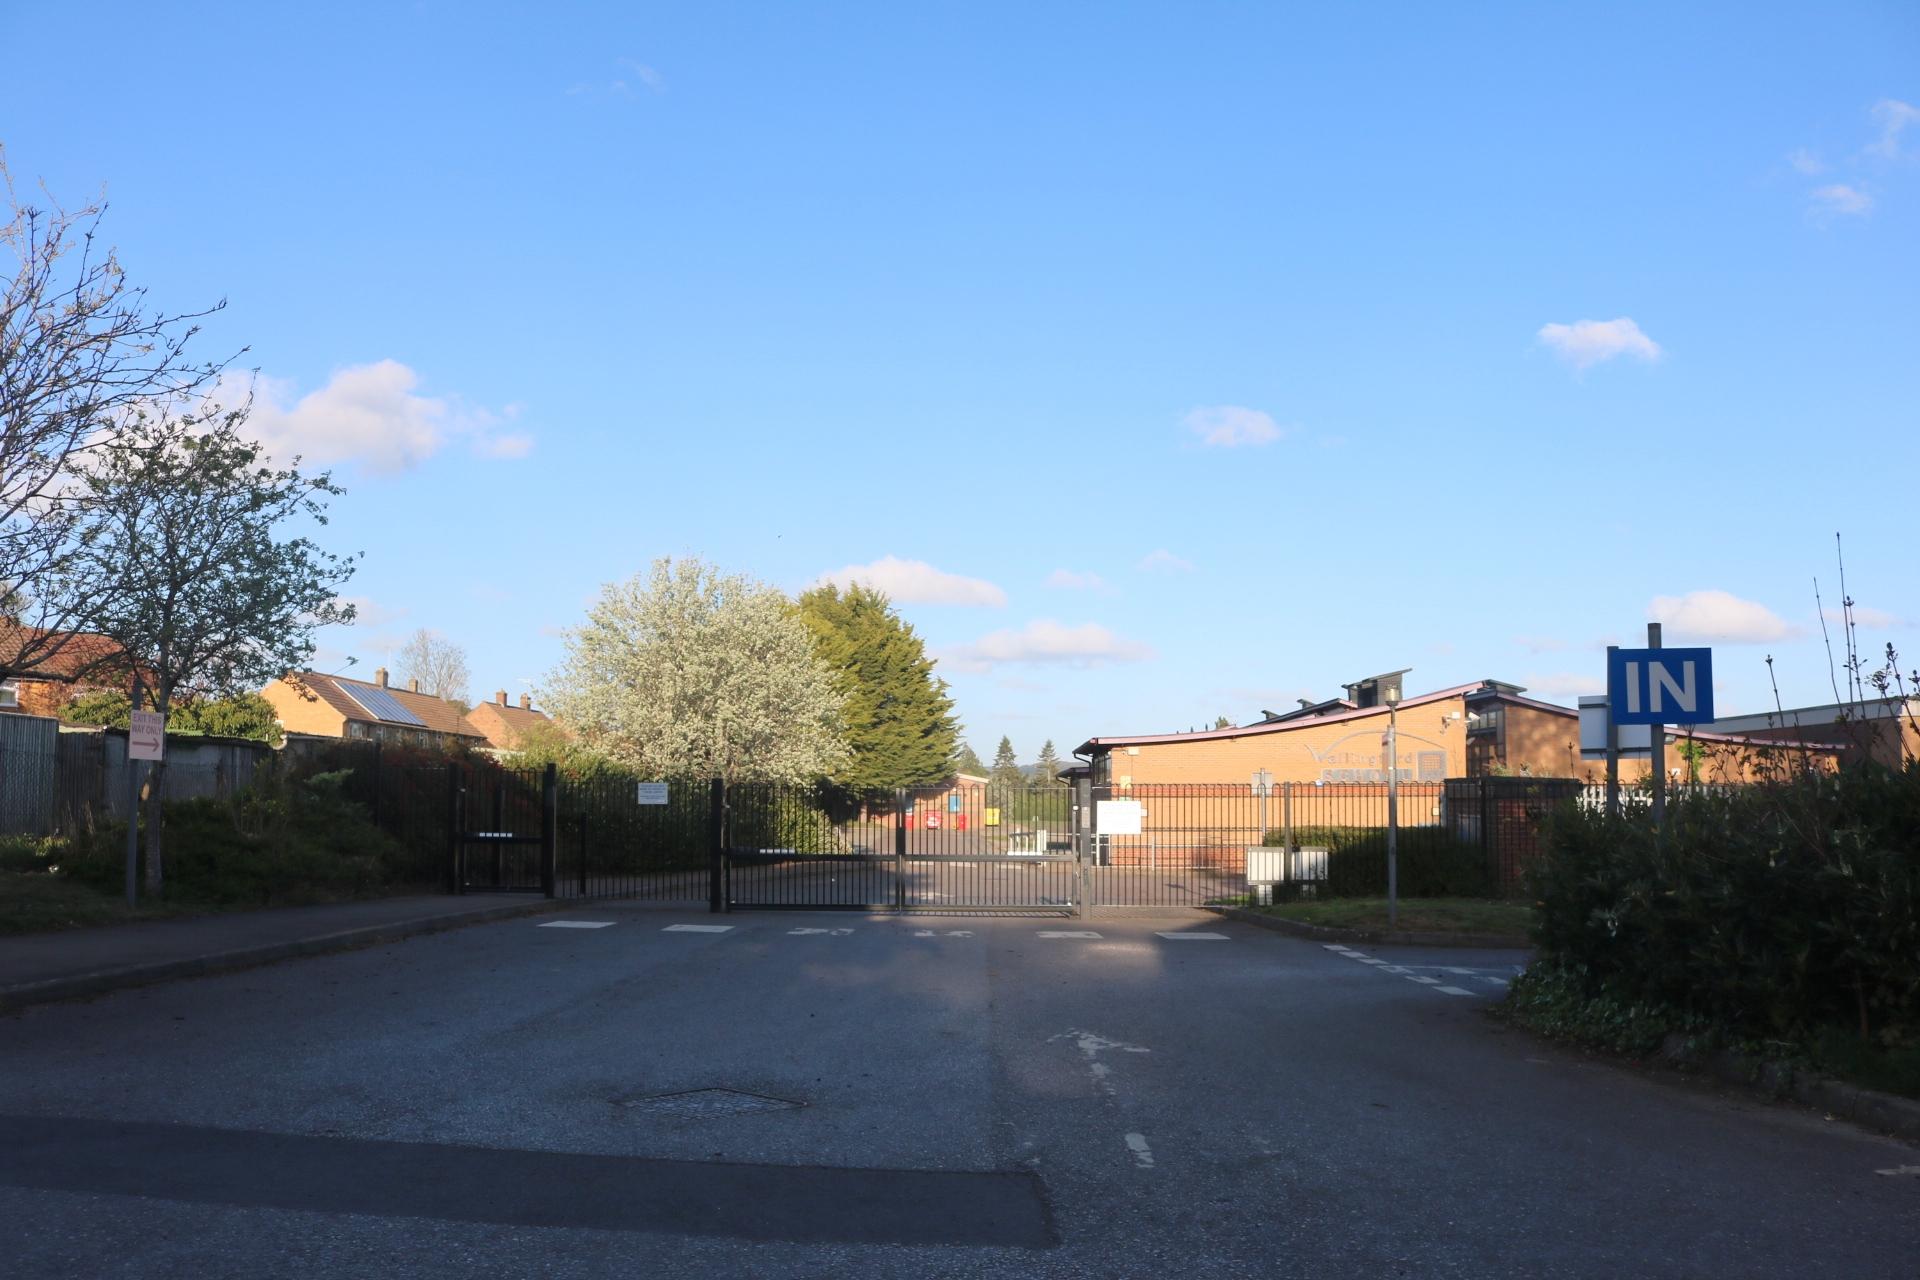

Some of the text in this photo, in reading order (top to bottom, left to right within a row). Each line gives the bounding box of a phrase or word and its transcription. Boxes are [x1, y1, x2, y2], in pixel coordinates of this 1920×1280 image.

[1625, 661, 1697, 713] IN
[133, 713, 146, 722] EXIT
[132, 724, 161, 735] WAY ONLY
